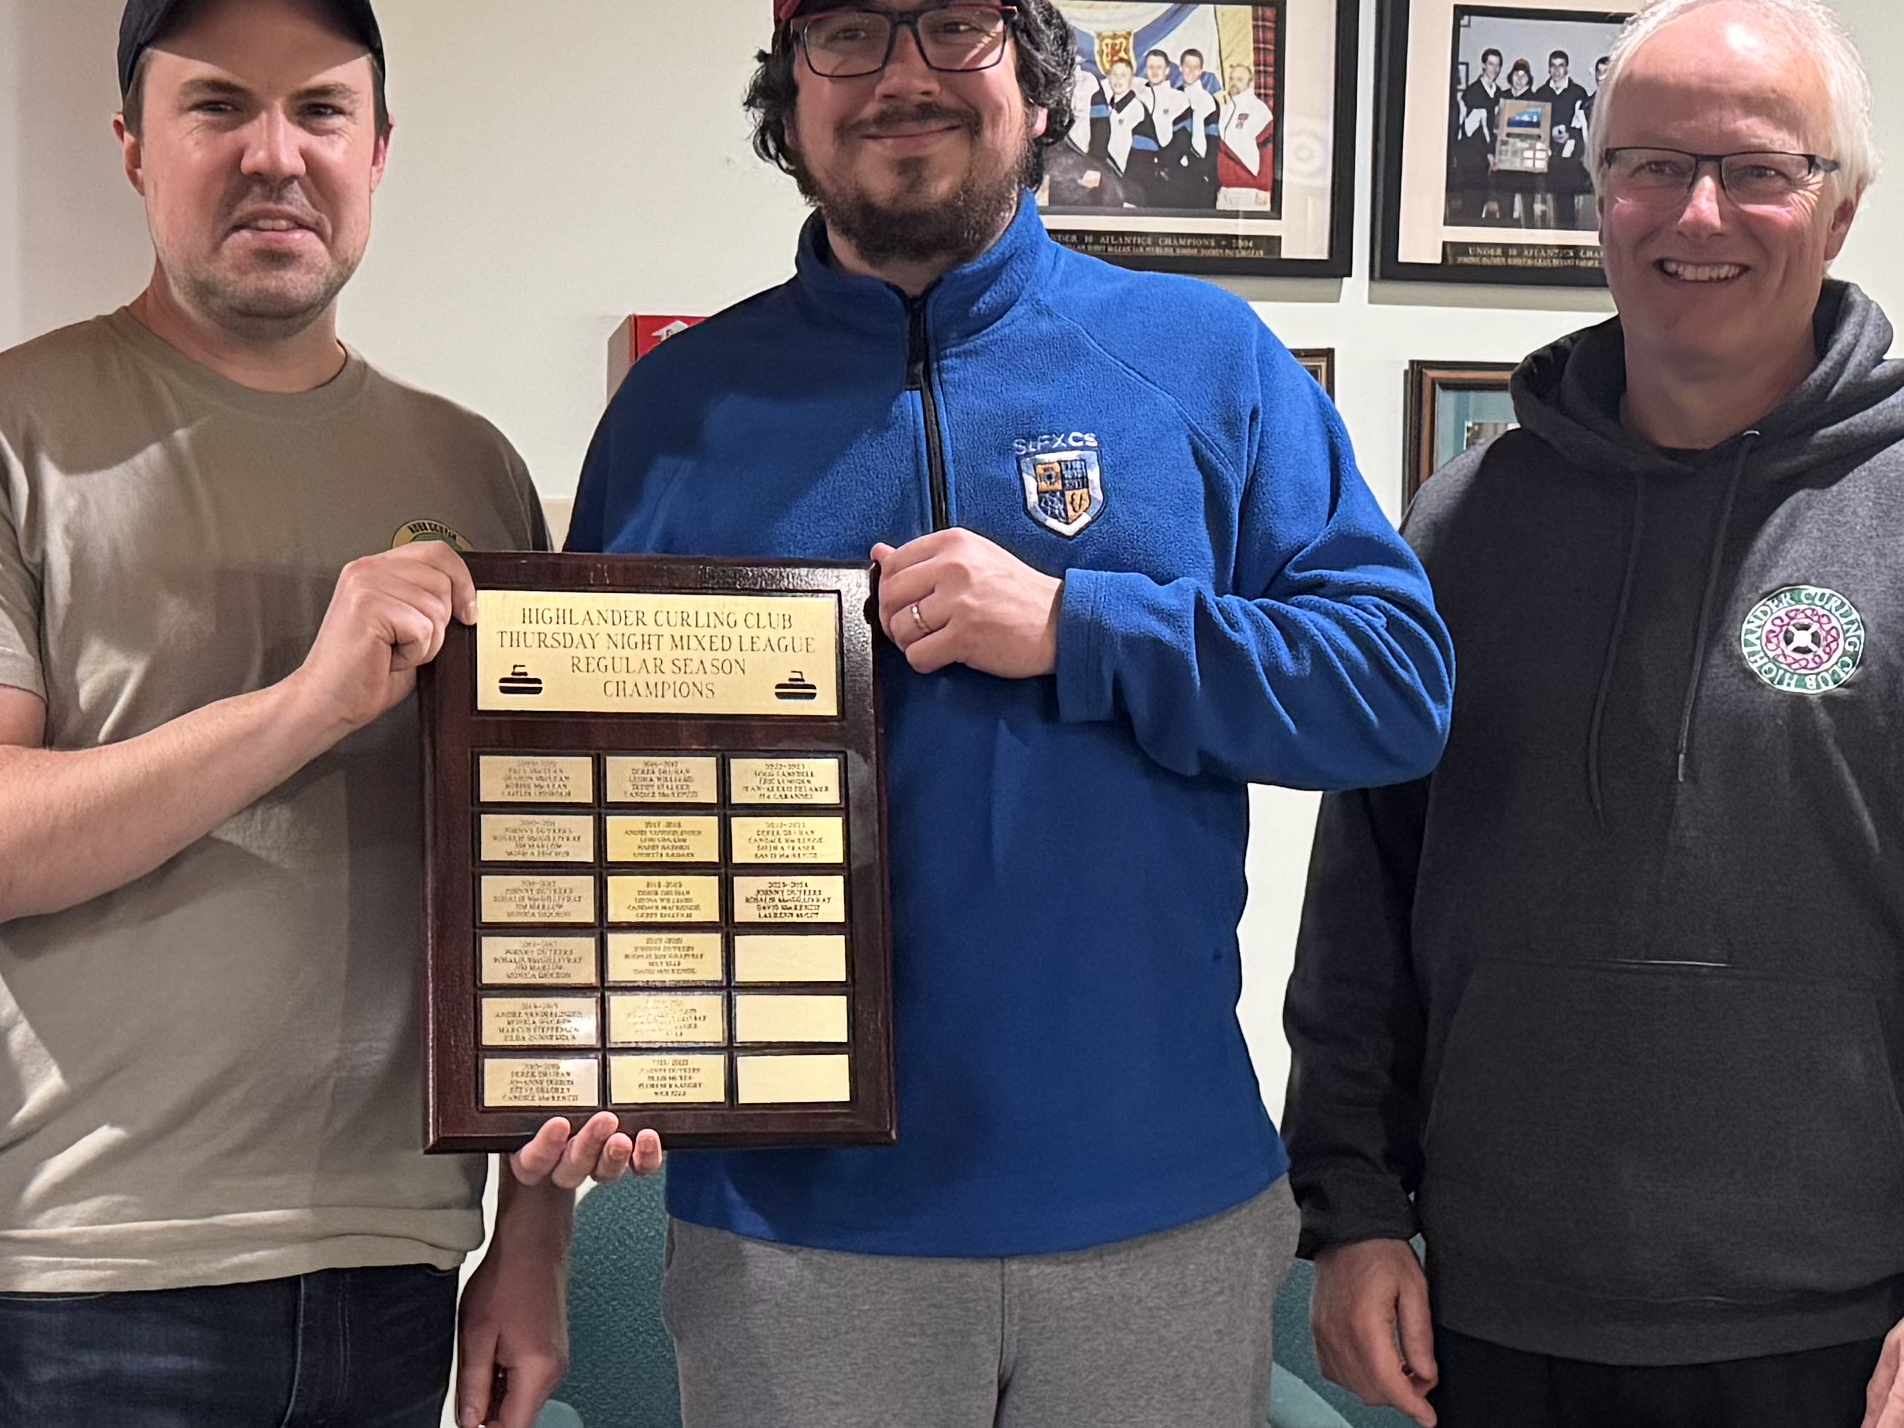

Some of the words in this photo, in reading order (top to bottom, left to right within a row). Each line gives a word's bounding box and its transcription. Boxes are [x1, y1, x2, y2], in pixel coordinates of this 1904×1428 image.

[1158, 236, 1216, 247] CHAMPIONS
[521, 607, 647, 627] HIGHLANDER
[654, 610, 737, 628] CURLING
[744, 612, 793, 630] CLUB
[1800, 589, 1860, 653] CURLING
[497, 630, 600, 649] THURSDAY
[607, 633, 664, 651] NIGHT
[670, 634, 732, 652] MIXED
[738, 635, 816, 654] LEAGUE
[571, 656, 665, 674] REGULAR
[671, 657, 746, 675] SEASON
[1805, 656, 1853, 689] CLUB
[603, 681, 715, 699] CHAMPIONS
